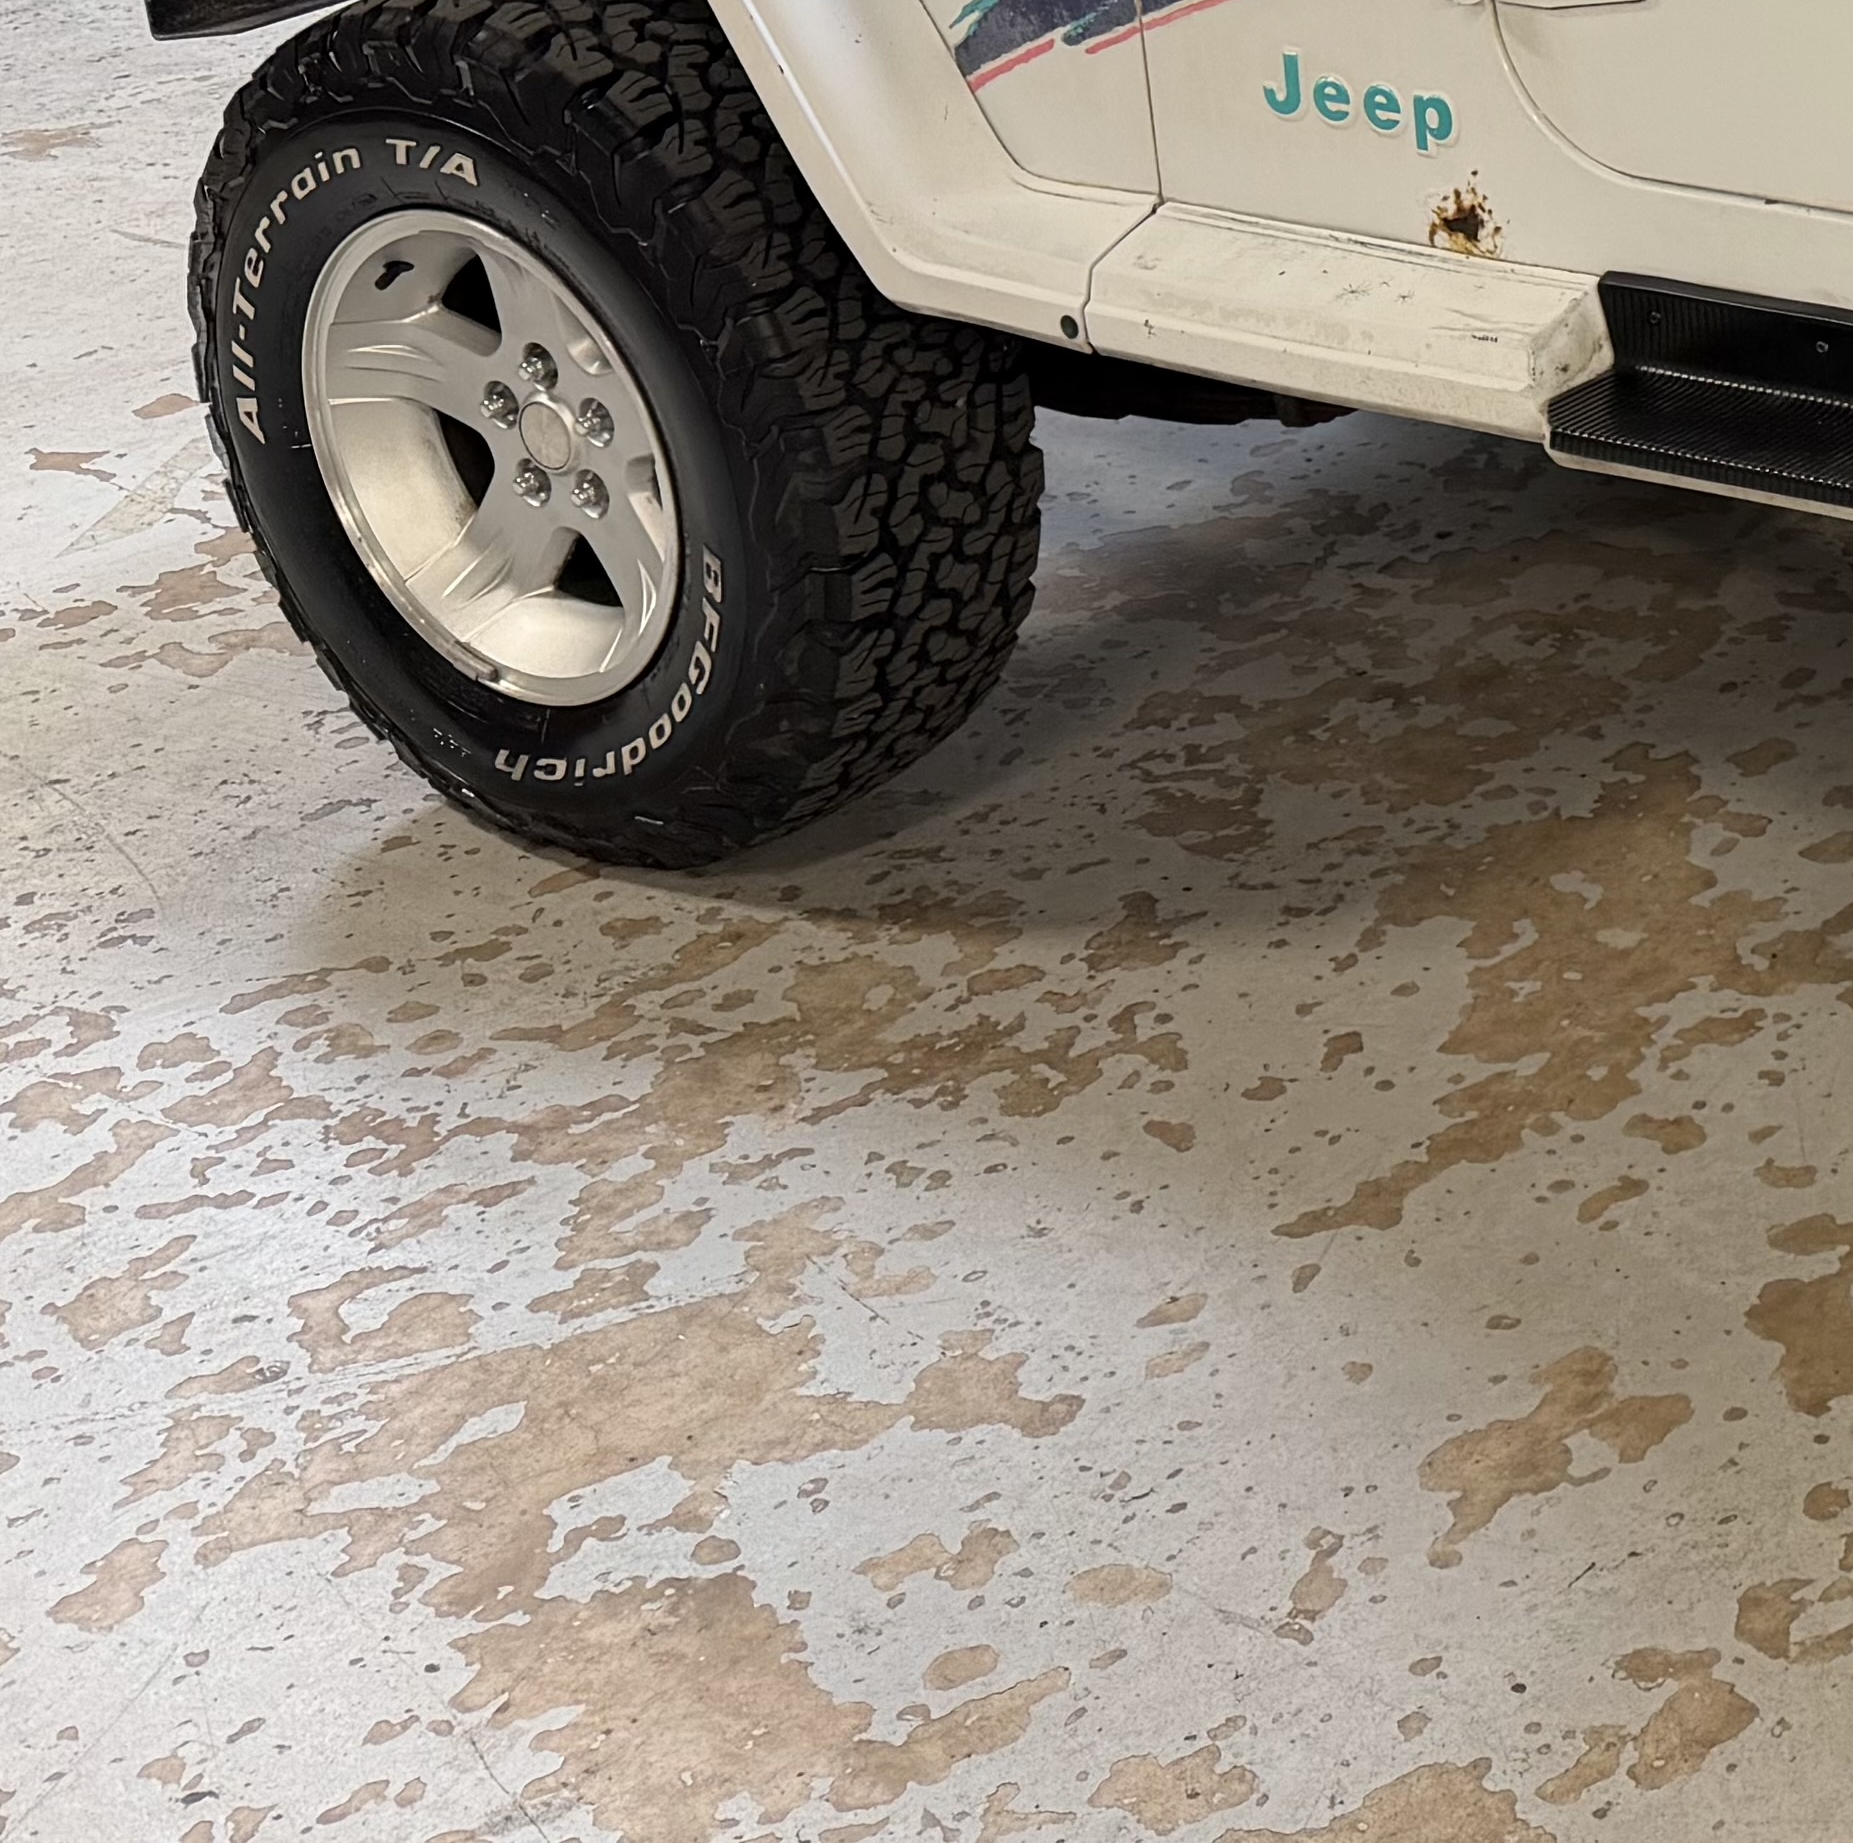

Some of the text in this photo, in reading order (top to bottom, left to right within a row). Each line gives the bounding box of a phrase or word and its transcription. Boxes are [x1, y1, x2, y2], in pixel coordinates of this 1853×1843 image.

[1262, 48, 1455, 152] Jeep
[228, 137, 482, 446] All-Terrain T/A
[492, 544, 728, 789] BFGoodrich
